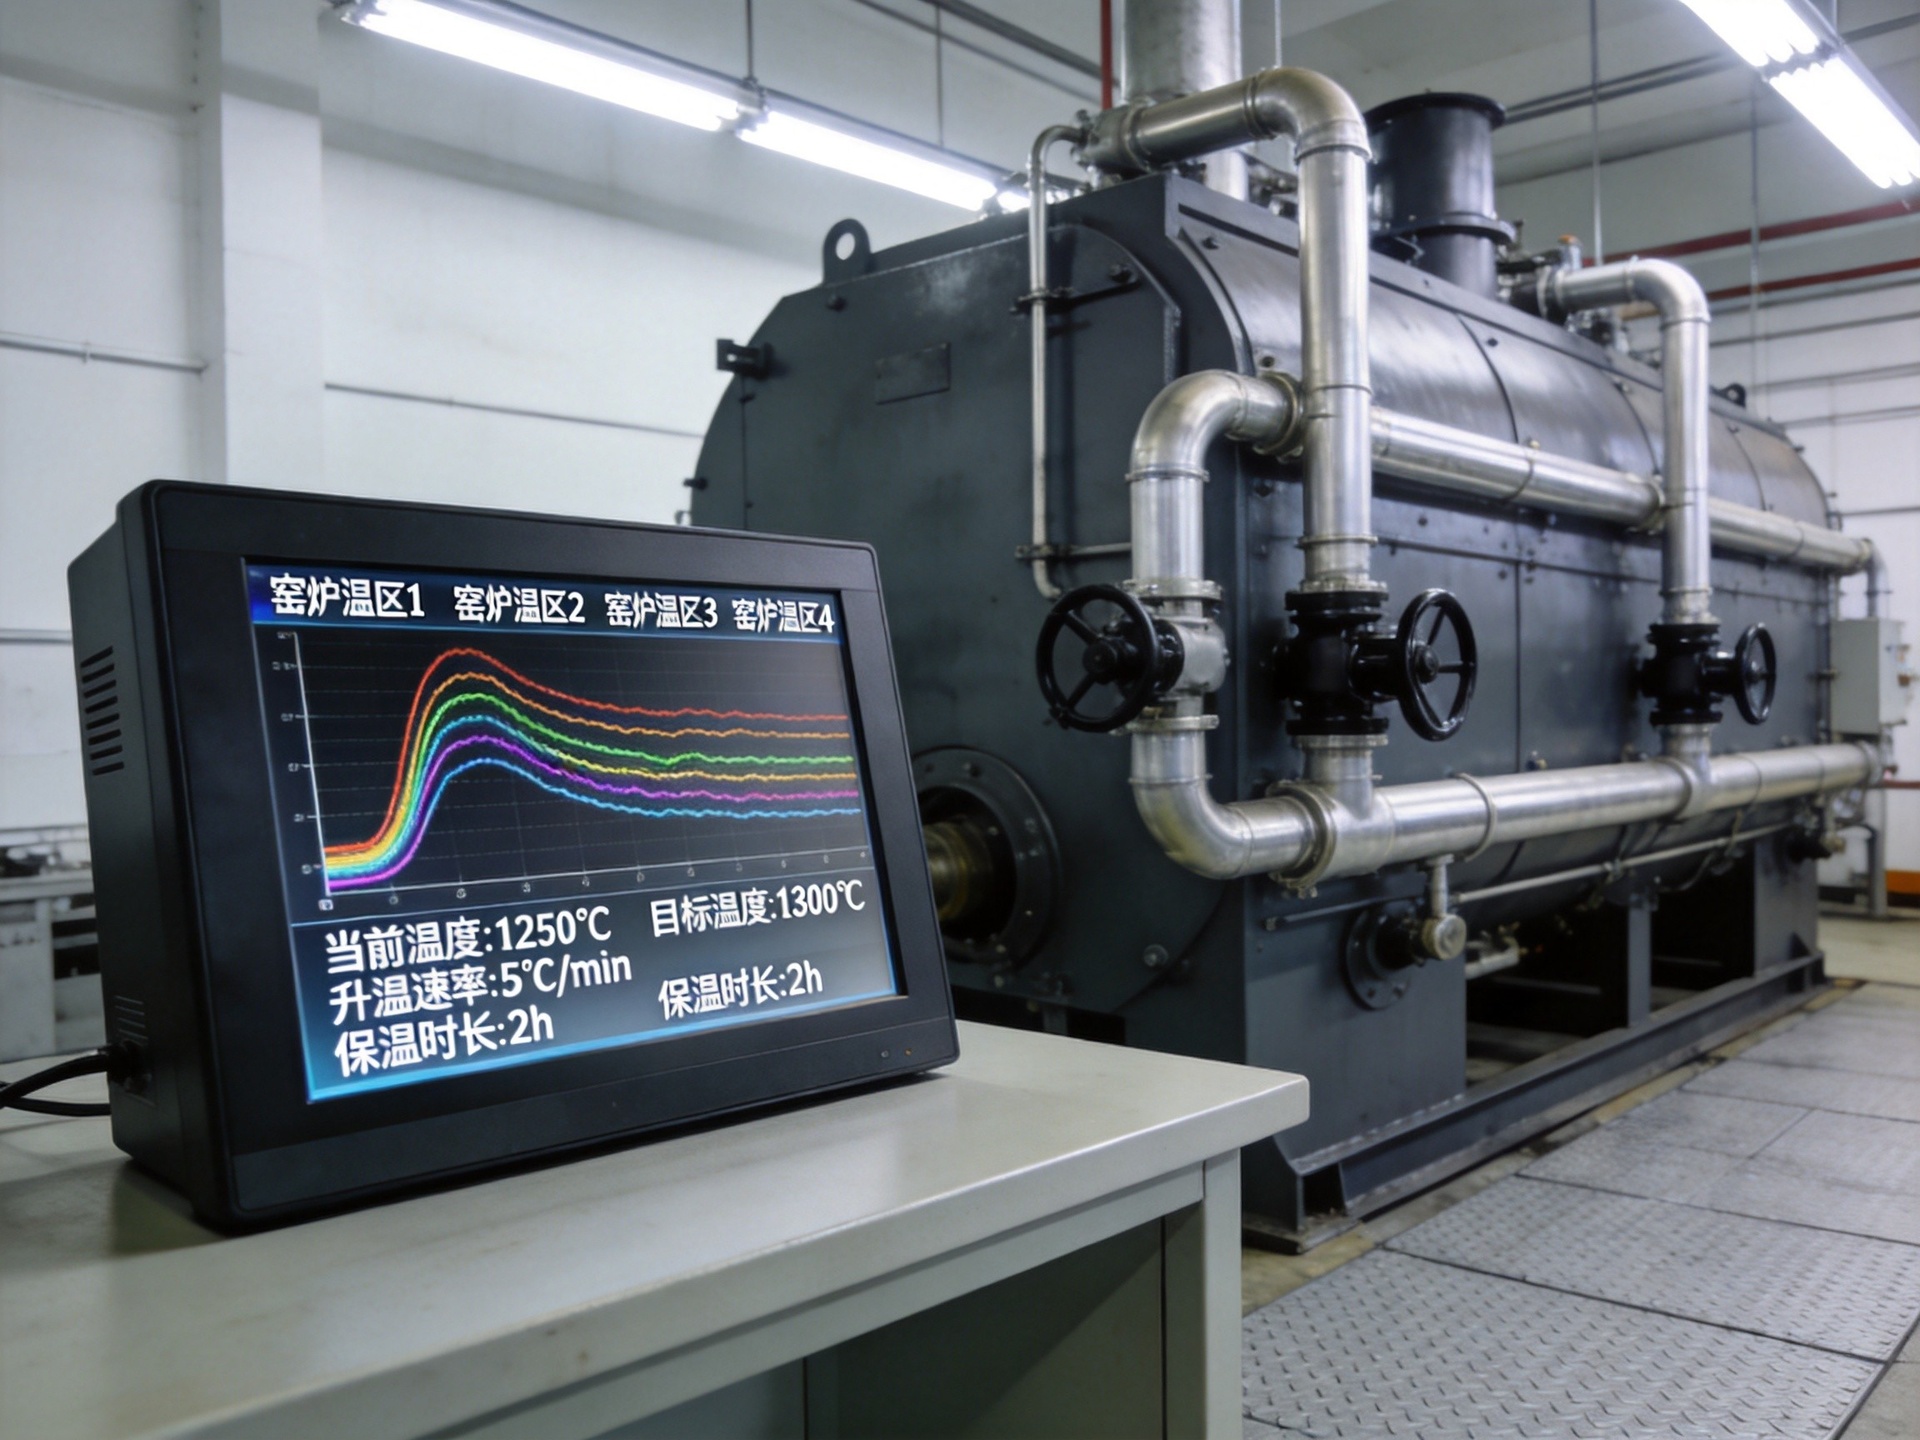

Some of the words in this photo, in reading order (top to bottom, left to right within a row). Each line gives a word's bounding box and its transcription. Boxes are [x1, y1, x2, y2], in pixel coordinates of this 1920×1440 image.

[269, 573, 426, 618] 窑炉温区1
[453, 583, 586, 624] 窑炉温区2
[604, 589, 719, 630] 窑炉温区3
[731, 597, 836, 634] 窑炉温区4
[657, 959, 824, 1021] 保温时长:2h
[334, 1003, 555, 1078] 保温时长:2h
